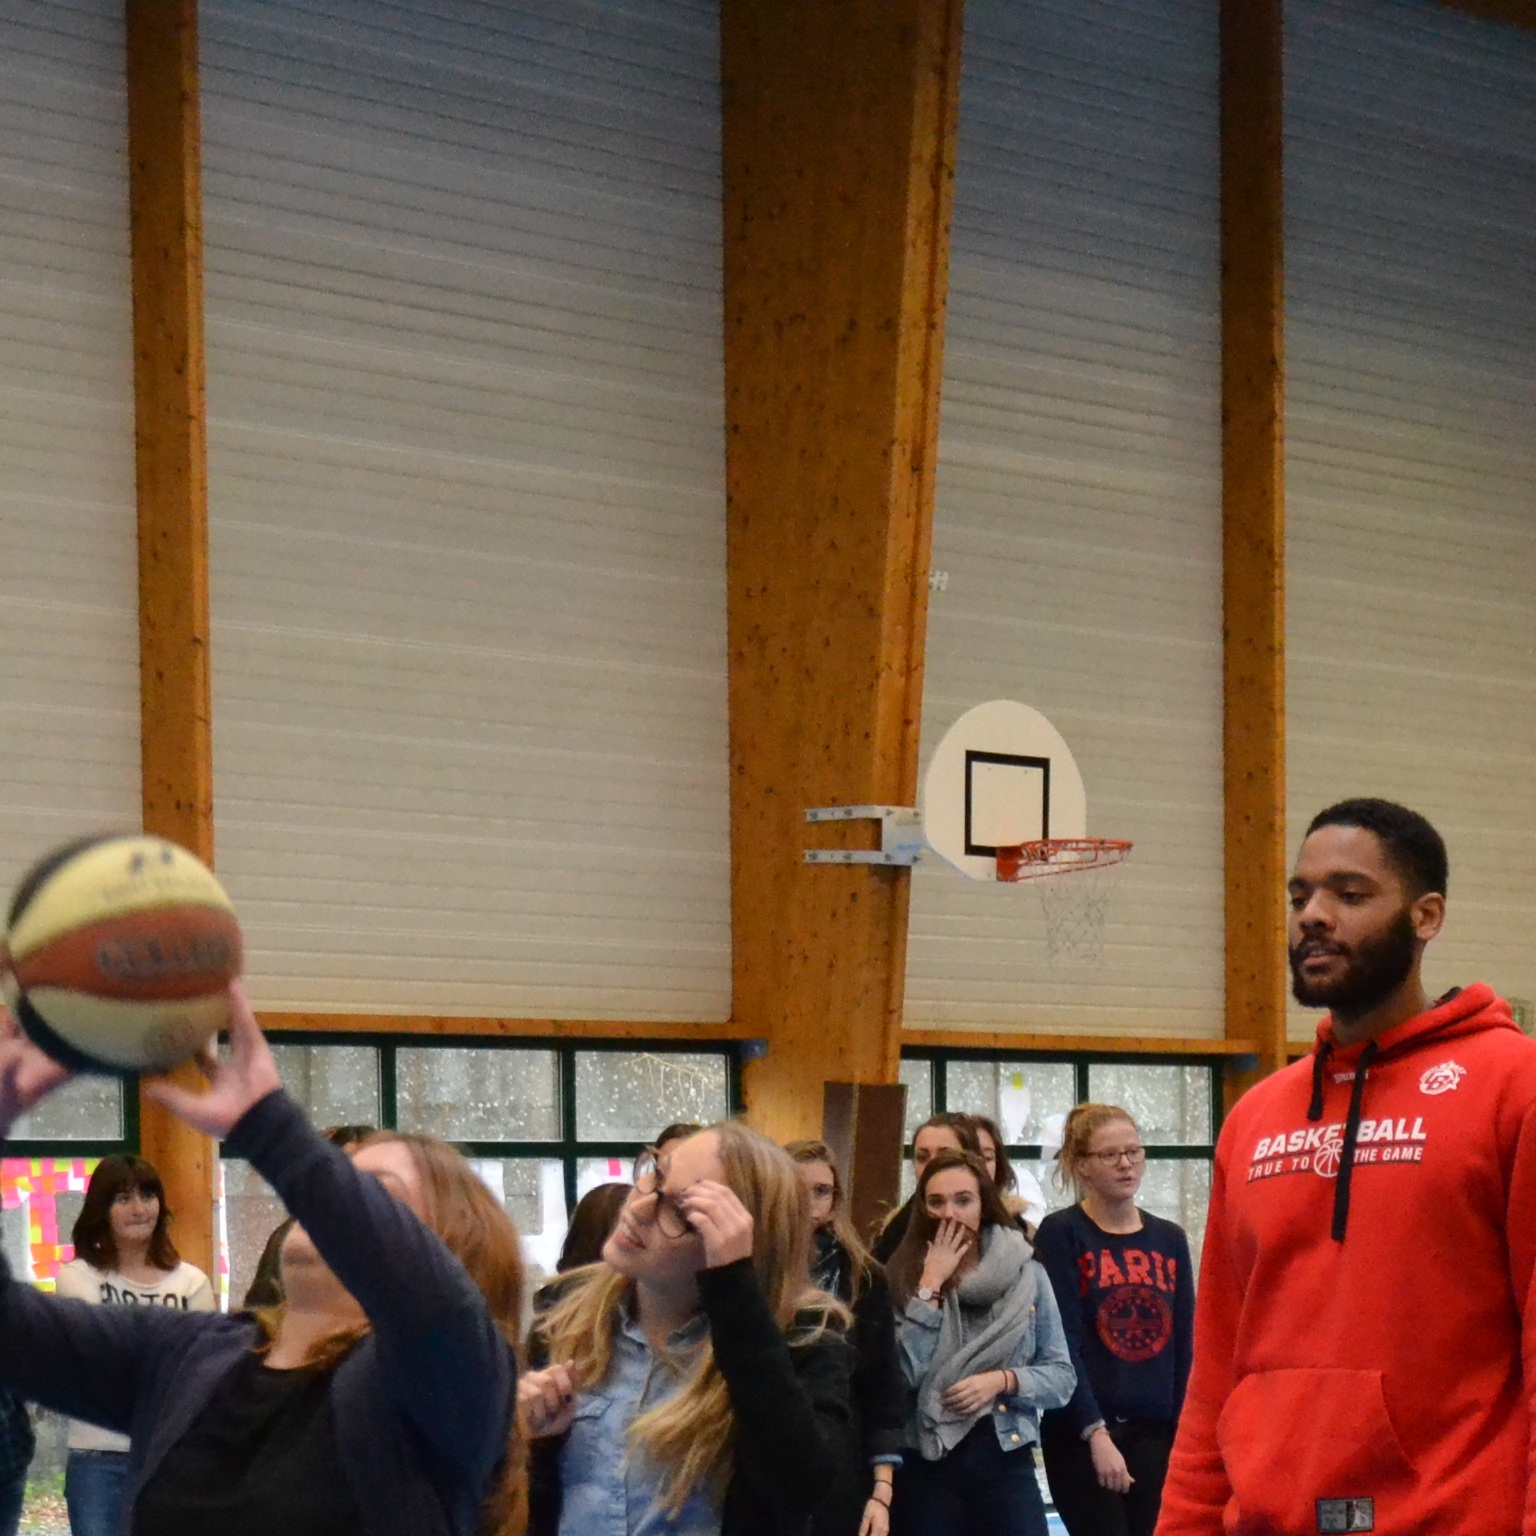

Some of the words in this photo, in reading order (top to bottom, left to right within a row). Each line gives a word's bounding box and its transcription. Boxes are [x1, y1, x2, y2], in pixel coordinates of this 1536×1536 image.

[1253, 1117, 1427, 1160] BASKEBALL
[1248, 1160, 1283, 1181] TRUE
[1292, 1156, 1310, 1170] TO
[1353, 1148, 1378, 1163] THE
[1382, 1147, 1423, 1161] GAME
